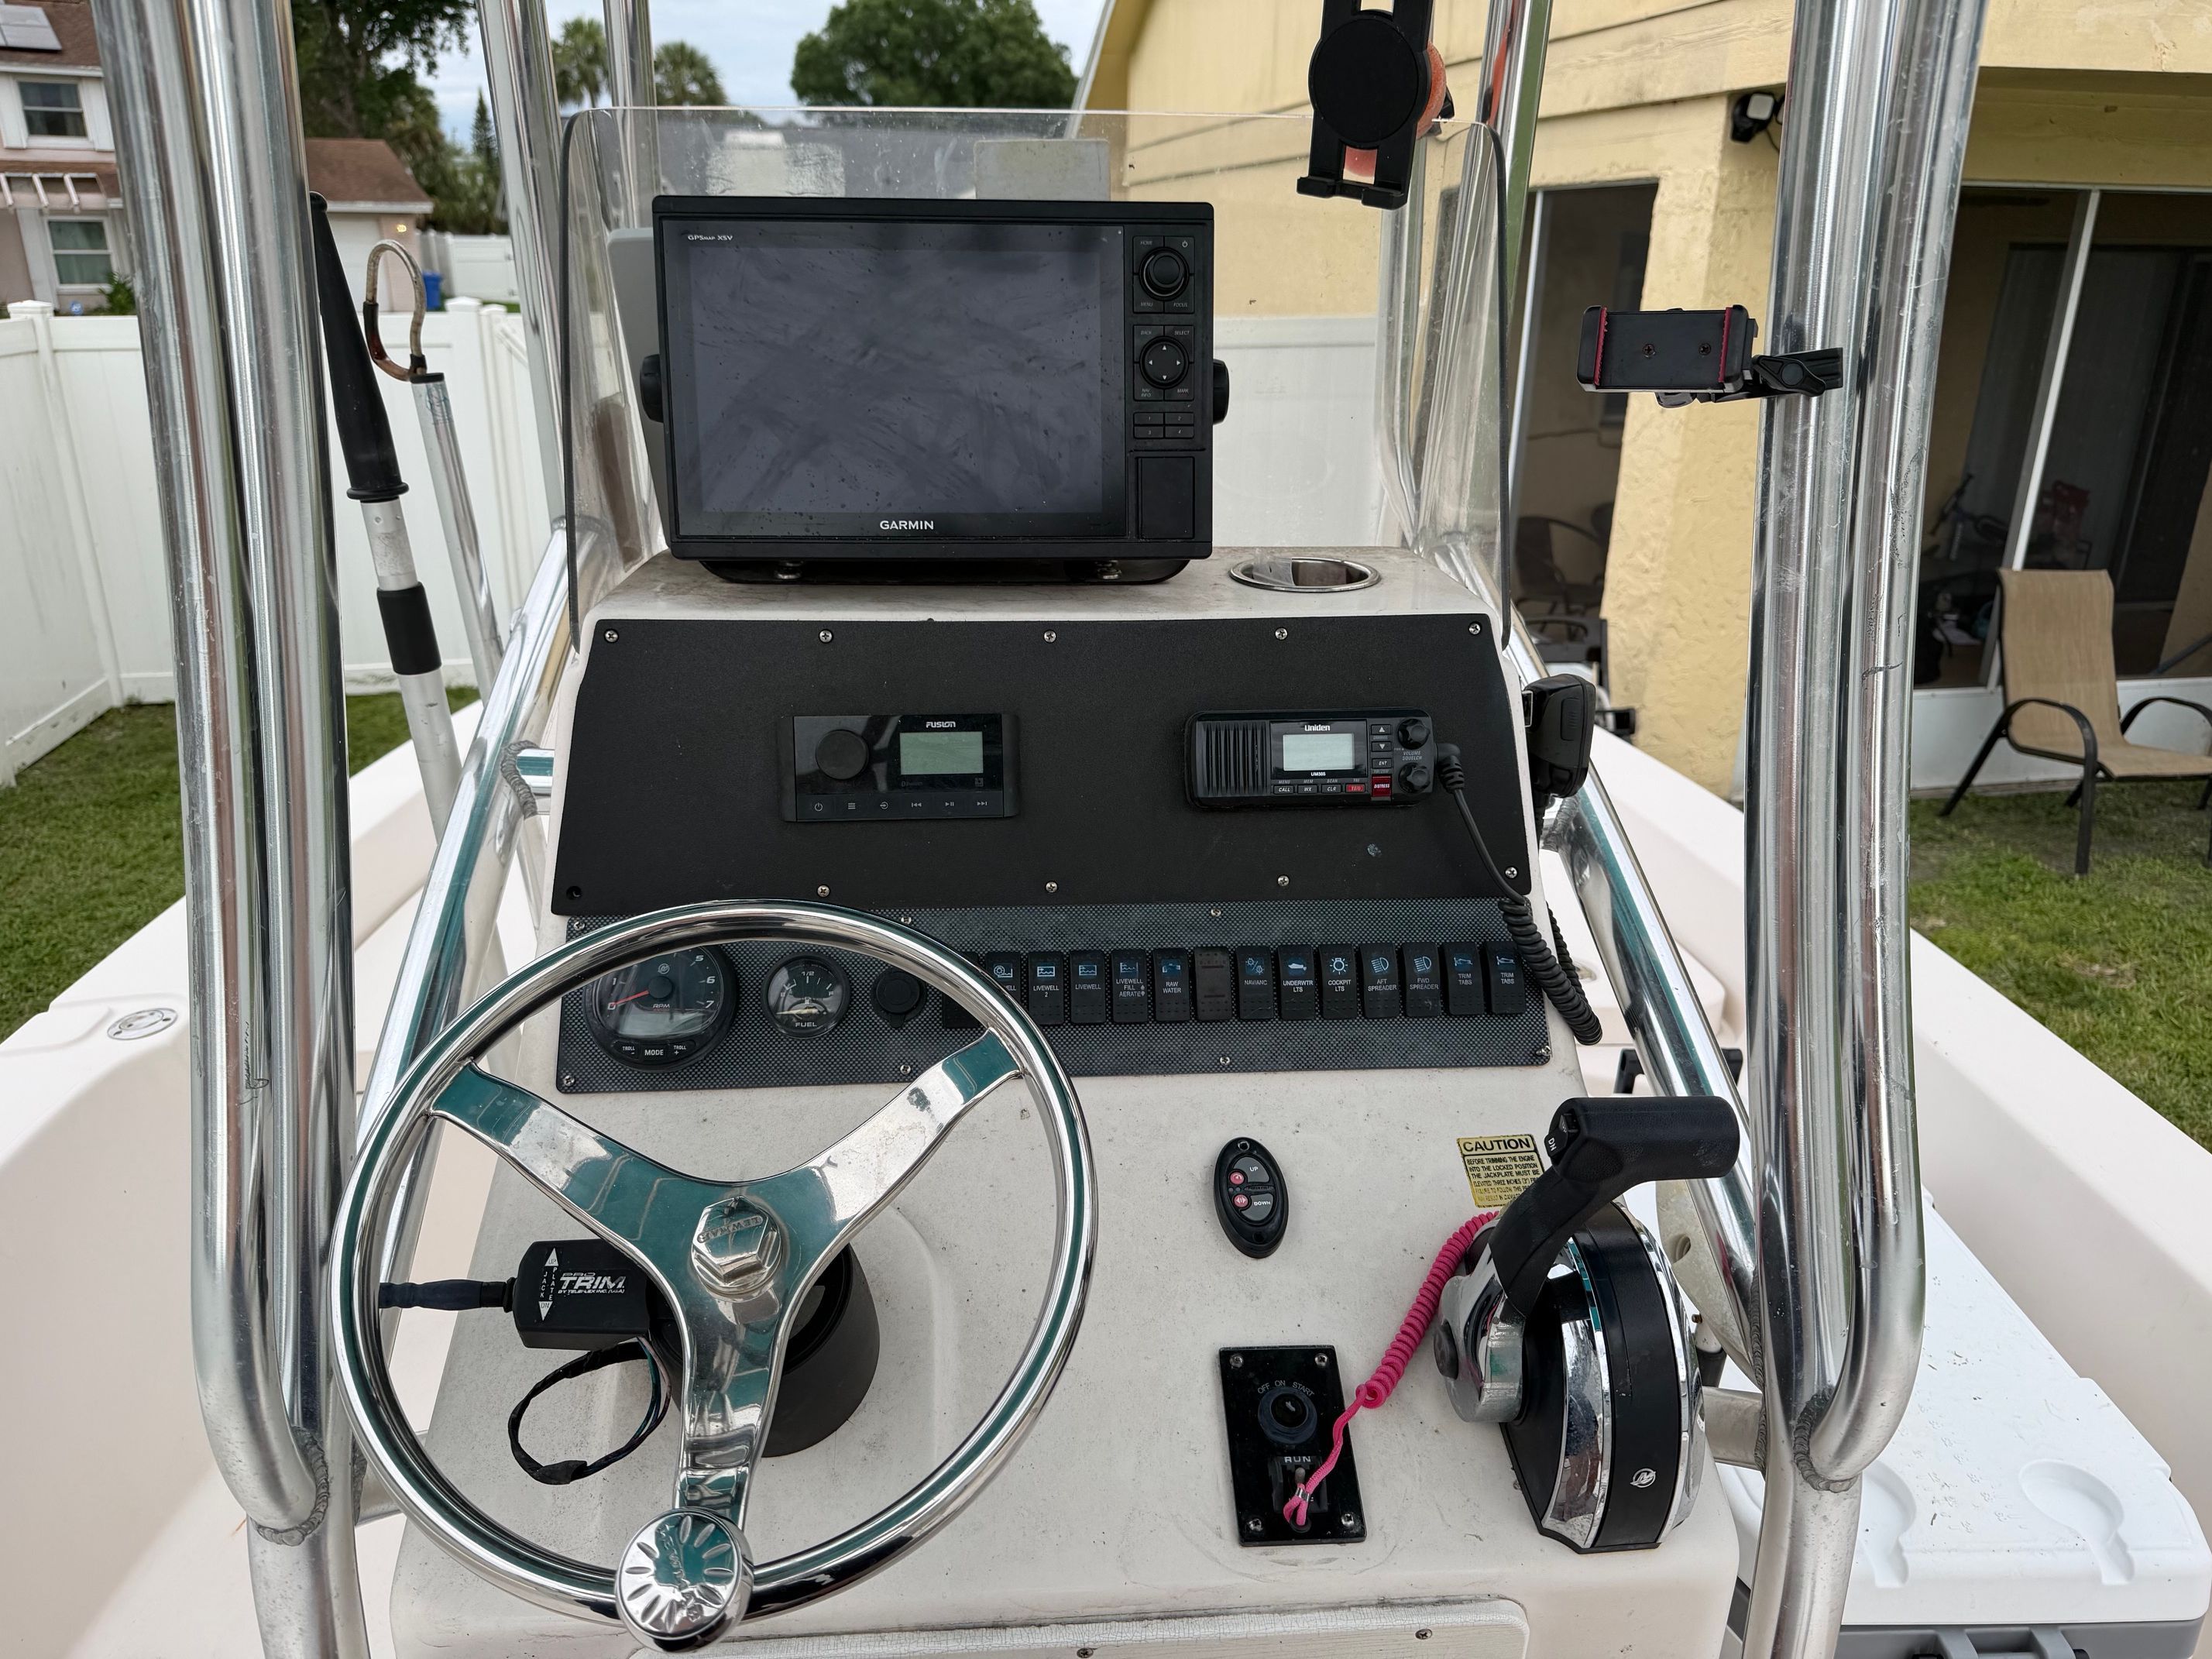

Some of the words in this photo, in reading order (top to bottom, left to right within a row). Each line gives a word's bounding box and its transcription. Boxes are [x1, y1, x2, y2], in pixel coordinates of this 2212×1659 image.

[879, 520, 934, 530] GARMIN
[1463, 1138, 1530, 1152] CAUTION
[548, 1267, 558, 1300] PLATE
[1258, 1382, 1270, 1394] OFF
[1292, 1382, 1314, 1396] START
